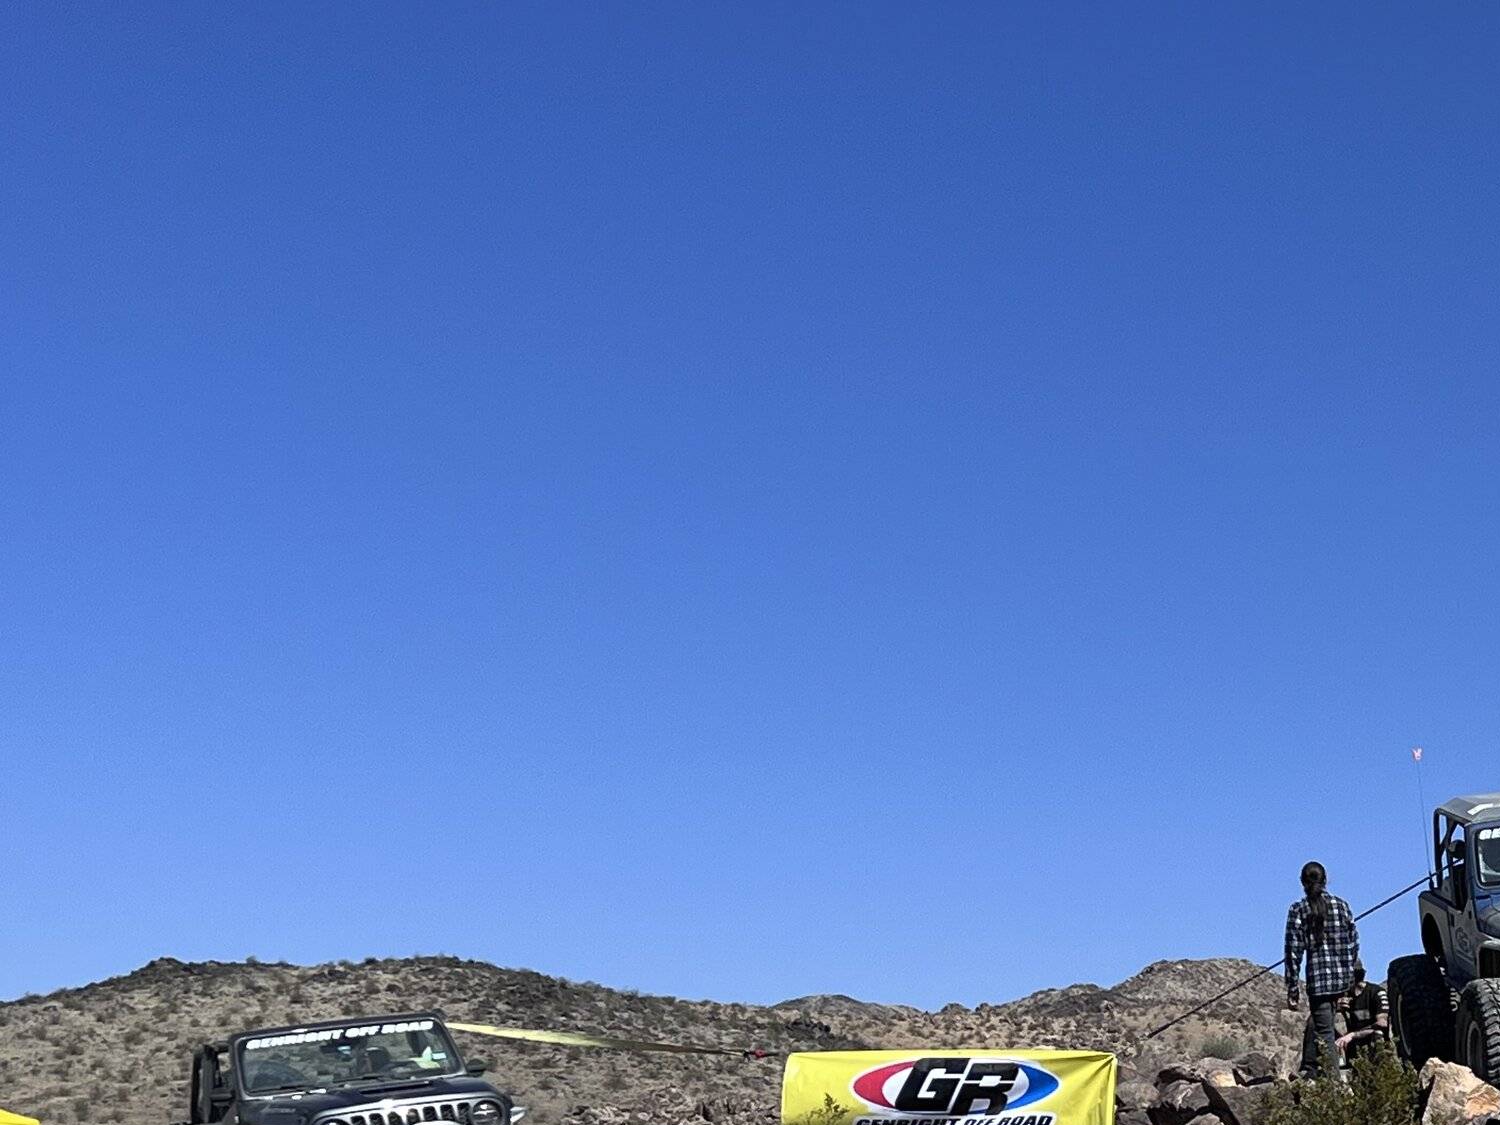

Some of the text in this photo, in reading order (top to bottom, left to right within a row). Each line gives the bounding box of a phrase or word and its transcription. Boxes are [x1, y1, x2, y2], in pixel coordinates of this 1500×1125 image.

[246, 1029, 344, 1049] GENRIGHT
[345, 1025, 381, 1038] OFF
[895, 1058, 1018, 1115] GR
